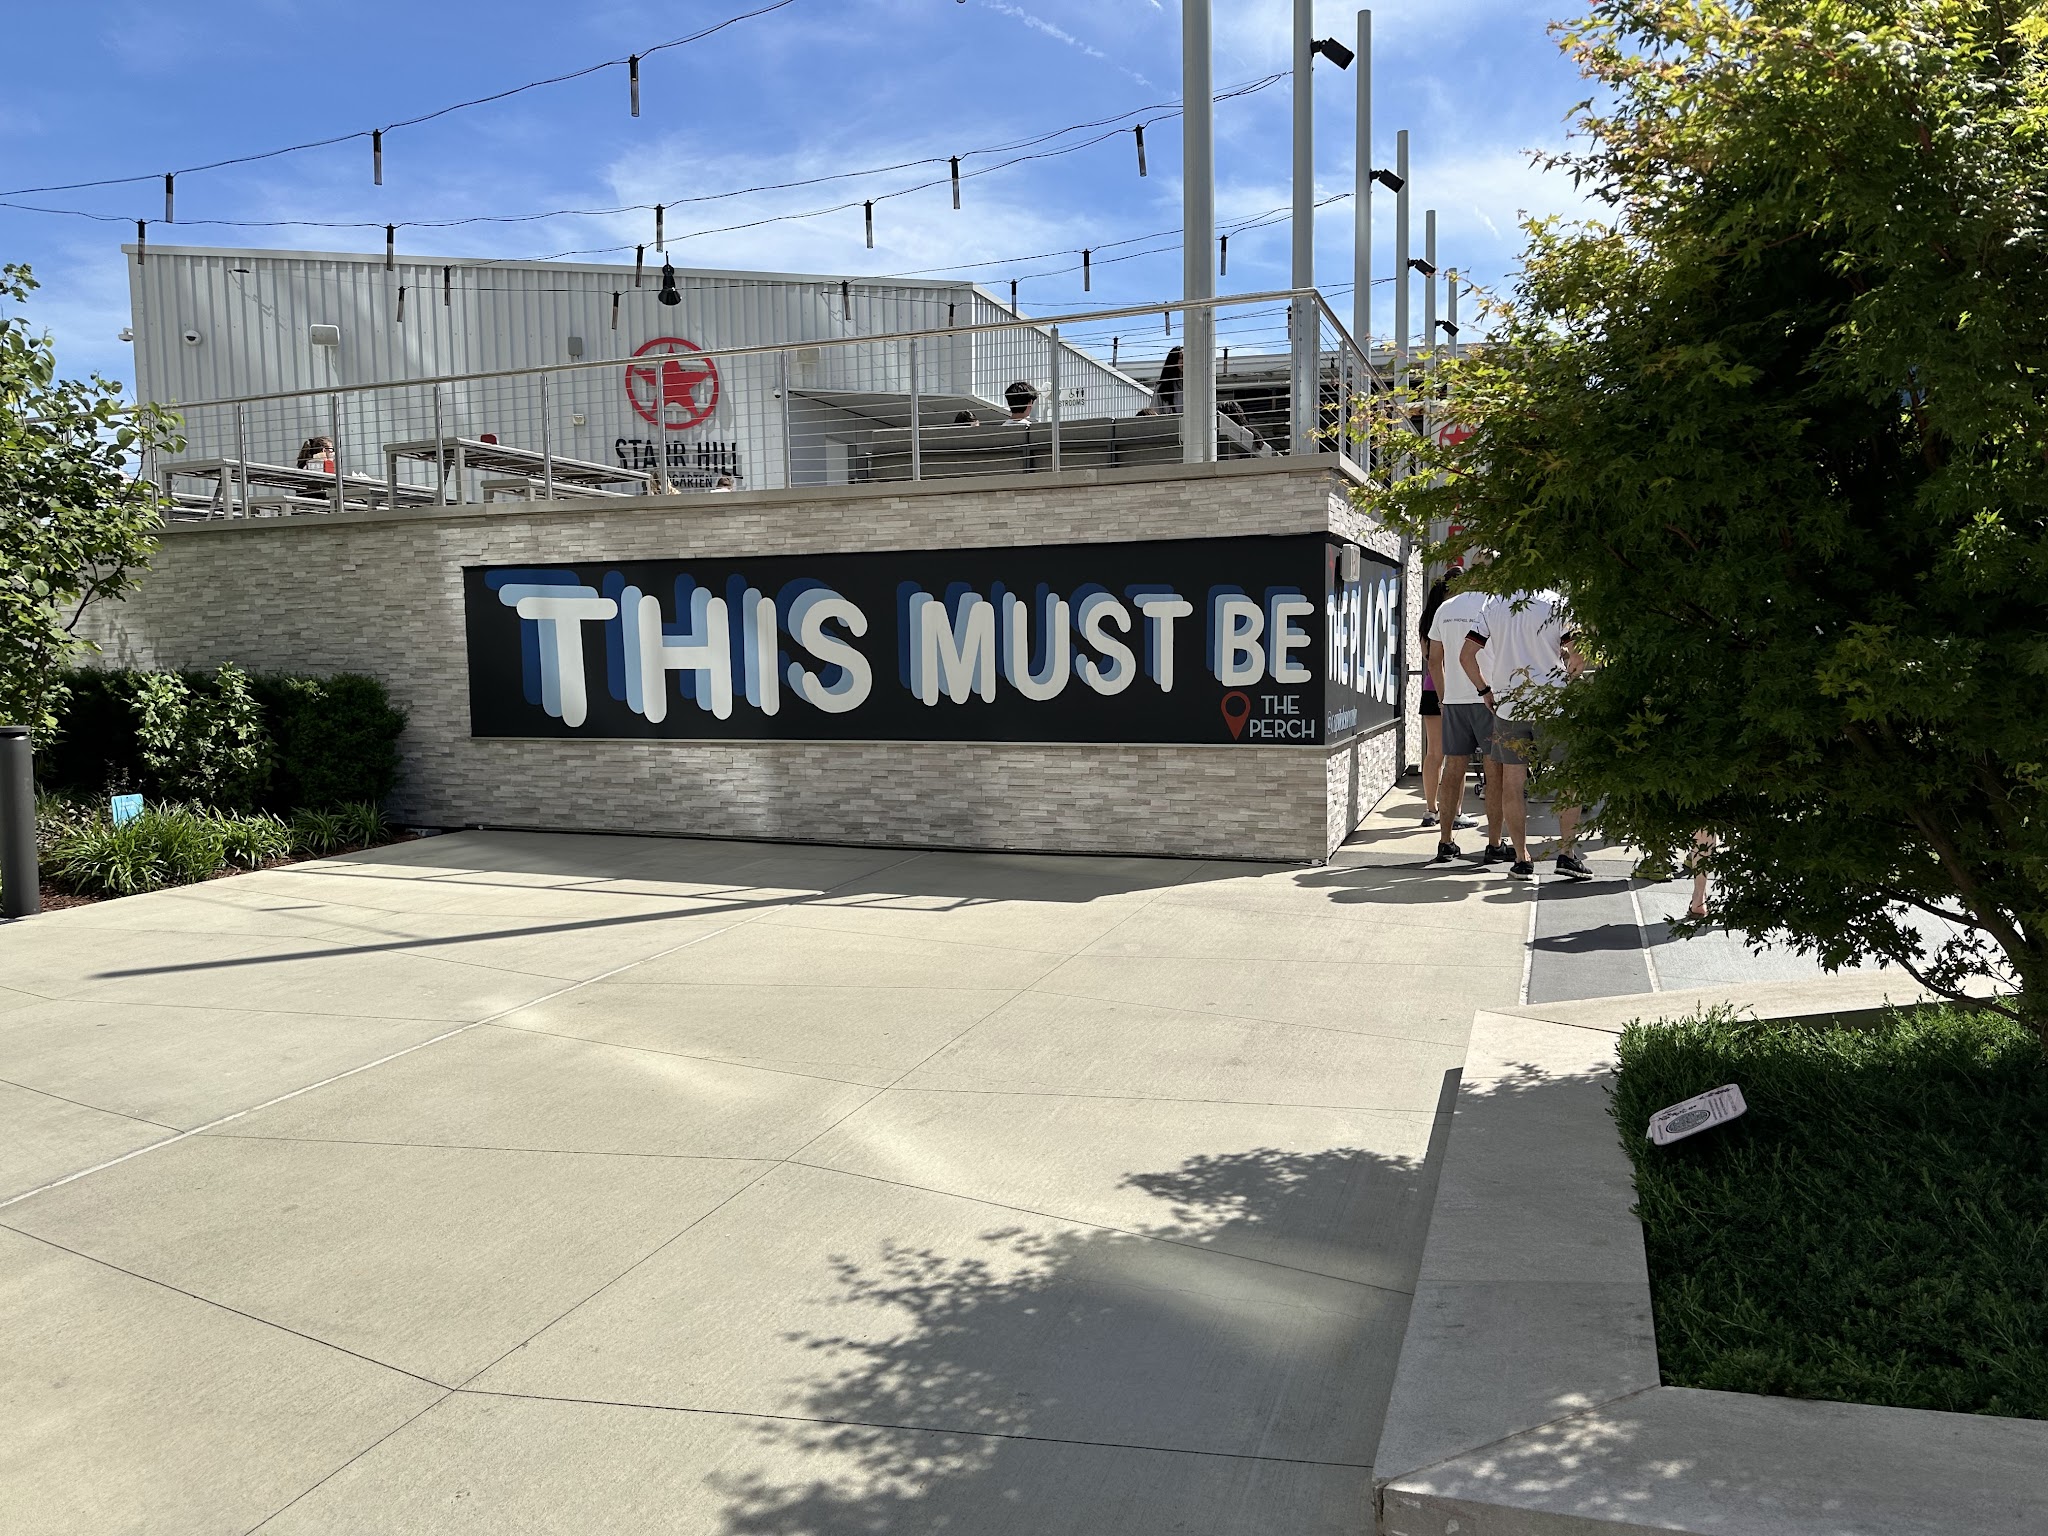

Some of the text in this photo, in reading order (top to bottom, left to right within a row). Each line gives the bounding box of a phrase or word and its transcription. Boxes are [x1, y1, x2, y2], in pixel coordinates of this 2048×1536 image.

[698, 441, 743, 479] HILL
[516, 594, 1315, 728] THIS MUST BE
[1327, 586, 1397, 706] THE PLACE
[1260, 695, 1300, 715] THE
[1249, 718, 1315, 739] PERCH
